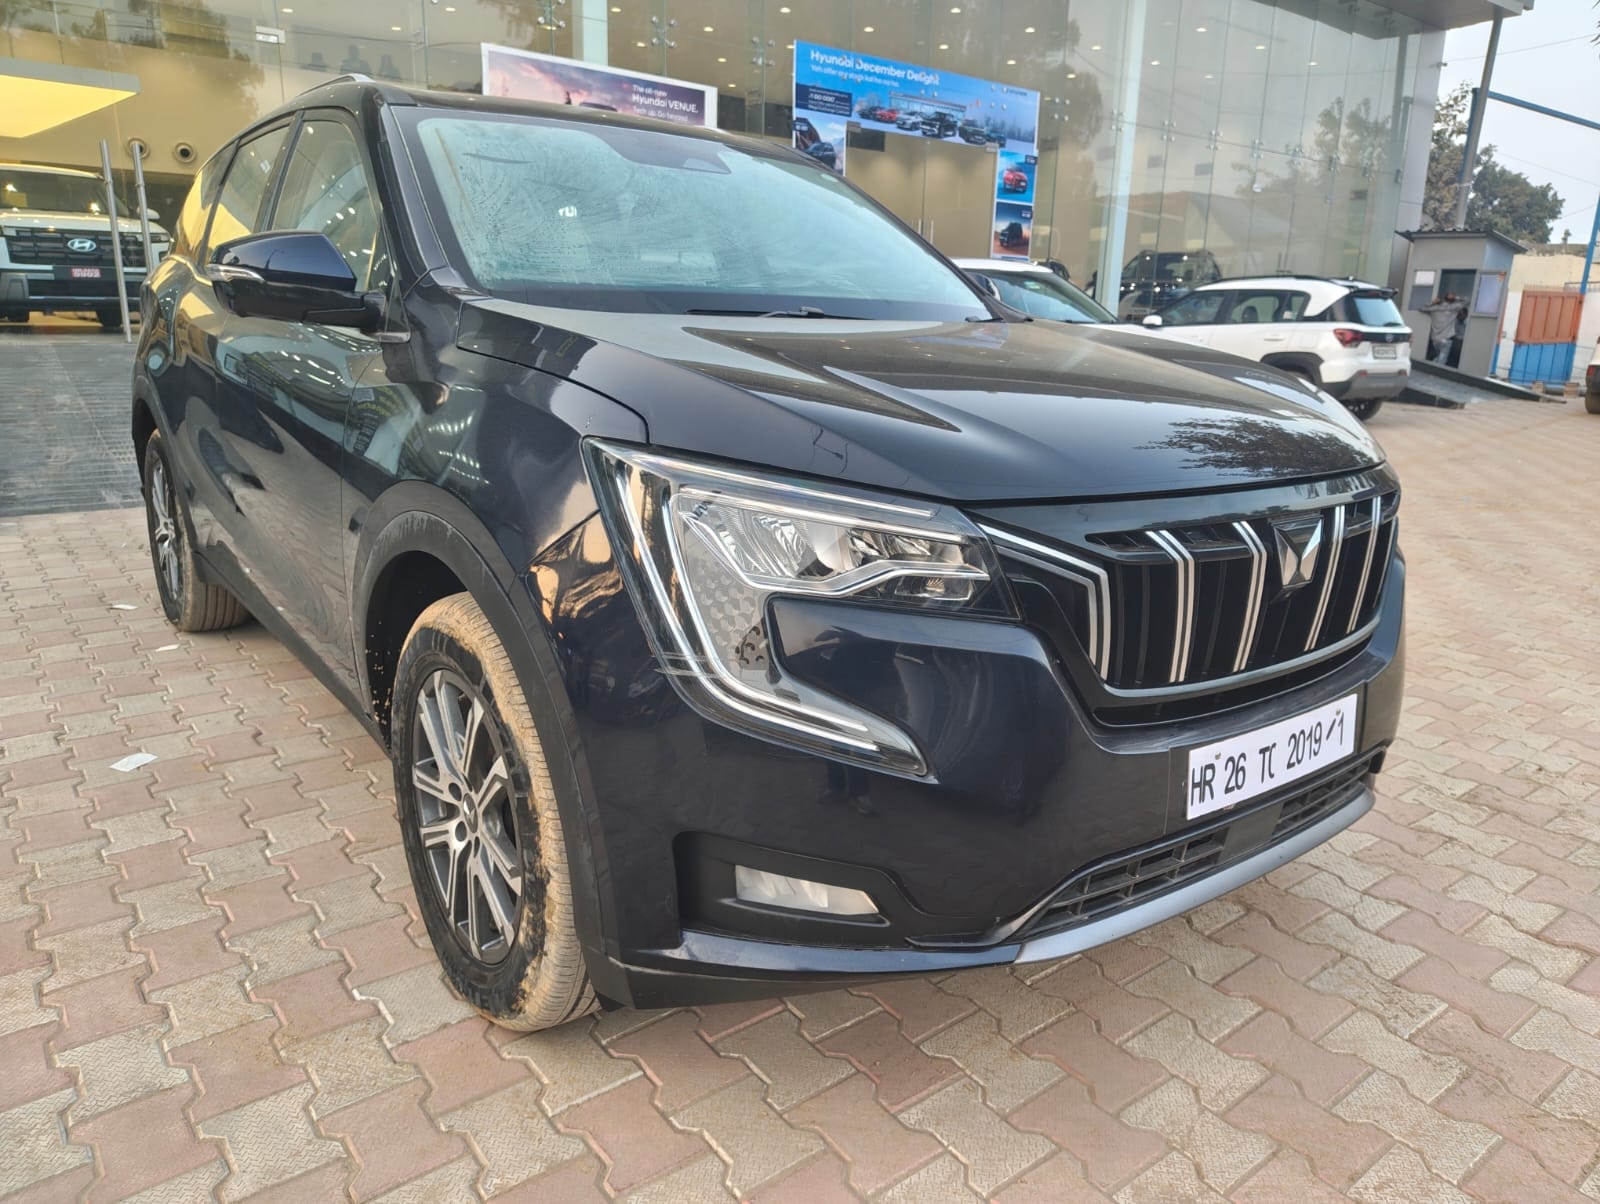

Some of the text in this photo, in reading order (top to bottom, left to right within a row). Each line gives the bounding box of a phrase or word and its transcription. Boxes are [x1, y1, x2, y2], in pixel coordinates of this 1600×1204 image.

[810, 50, 853, 68] Hyundai
[855, 59, 905, 79] December
[907, 70, 940, 86] Delight
[632, 84, 645, 93] The
[632, 93, 668, 108] Hyundai
[1190, 762, 1216, 806] HR
[1224, 752, 1246, 795] 26
[1259, 742, 1277, 784] TC
